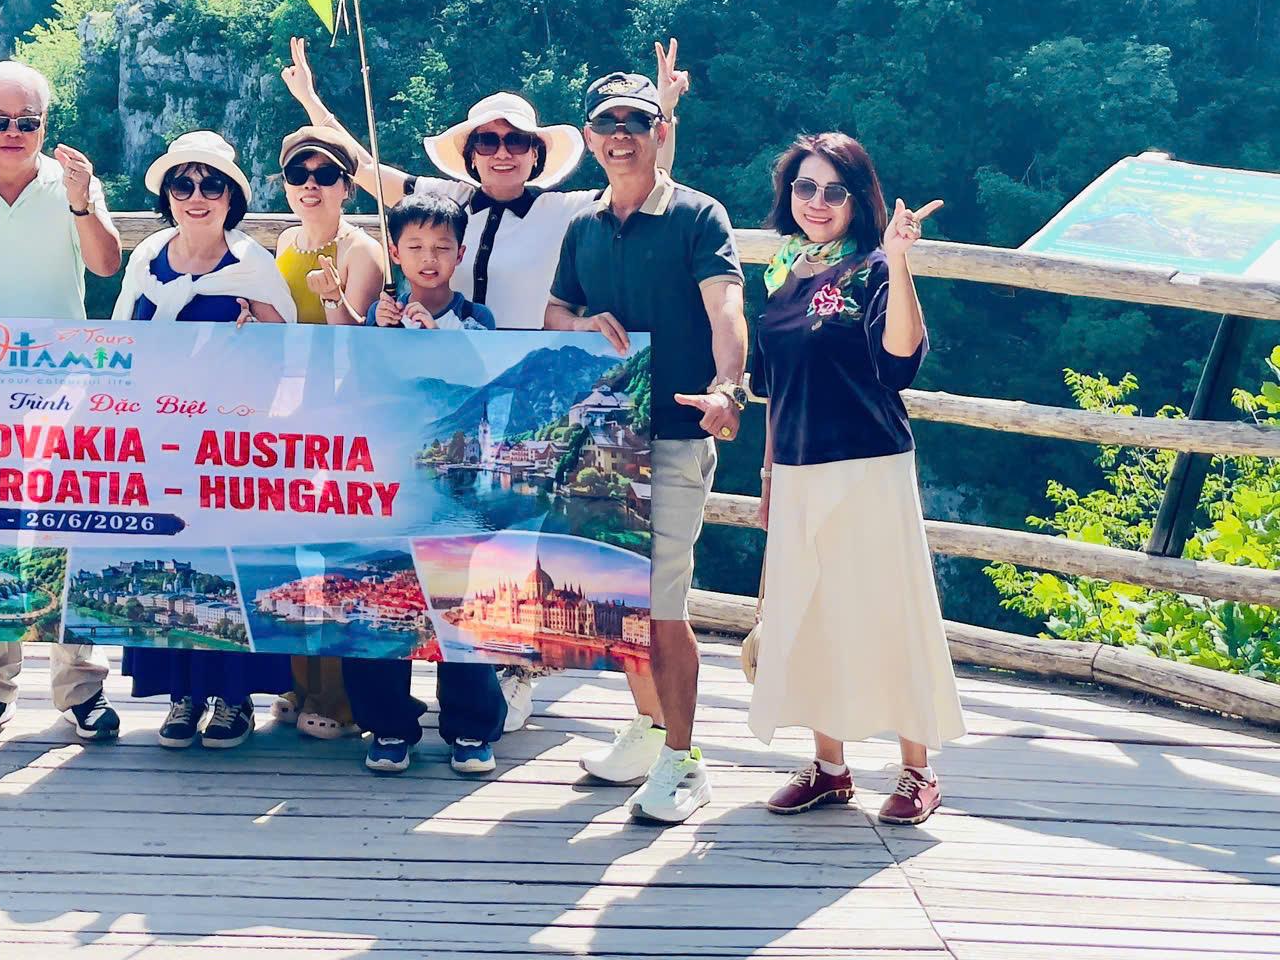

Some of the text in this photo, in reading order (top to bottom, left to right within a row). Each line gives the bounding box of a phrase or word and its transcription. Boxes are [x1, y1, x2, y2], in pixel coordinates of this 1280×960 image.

[83, 327, 136, 345] Tours
[0, 376, 30, 386] your
[9, 392, 74, 411] Trình
[89, 393, 142, 416] Đặc
[156, 394, 208, 418] Biệt
[194, 429, 375, 472] AUSTRIA
[199, 474, 401, 517] HUNGARY
[25, 511, 155, 531] 26/6/2026
